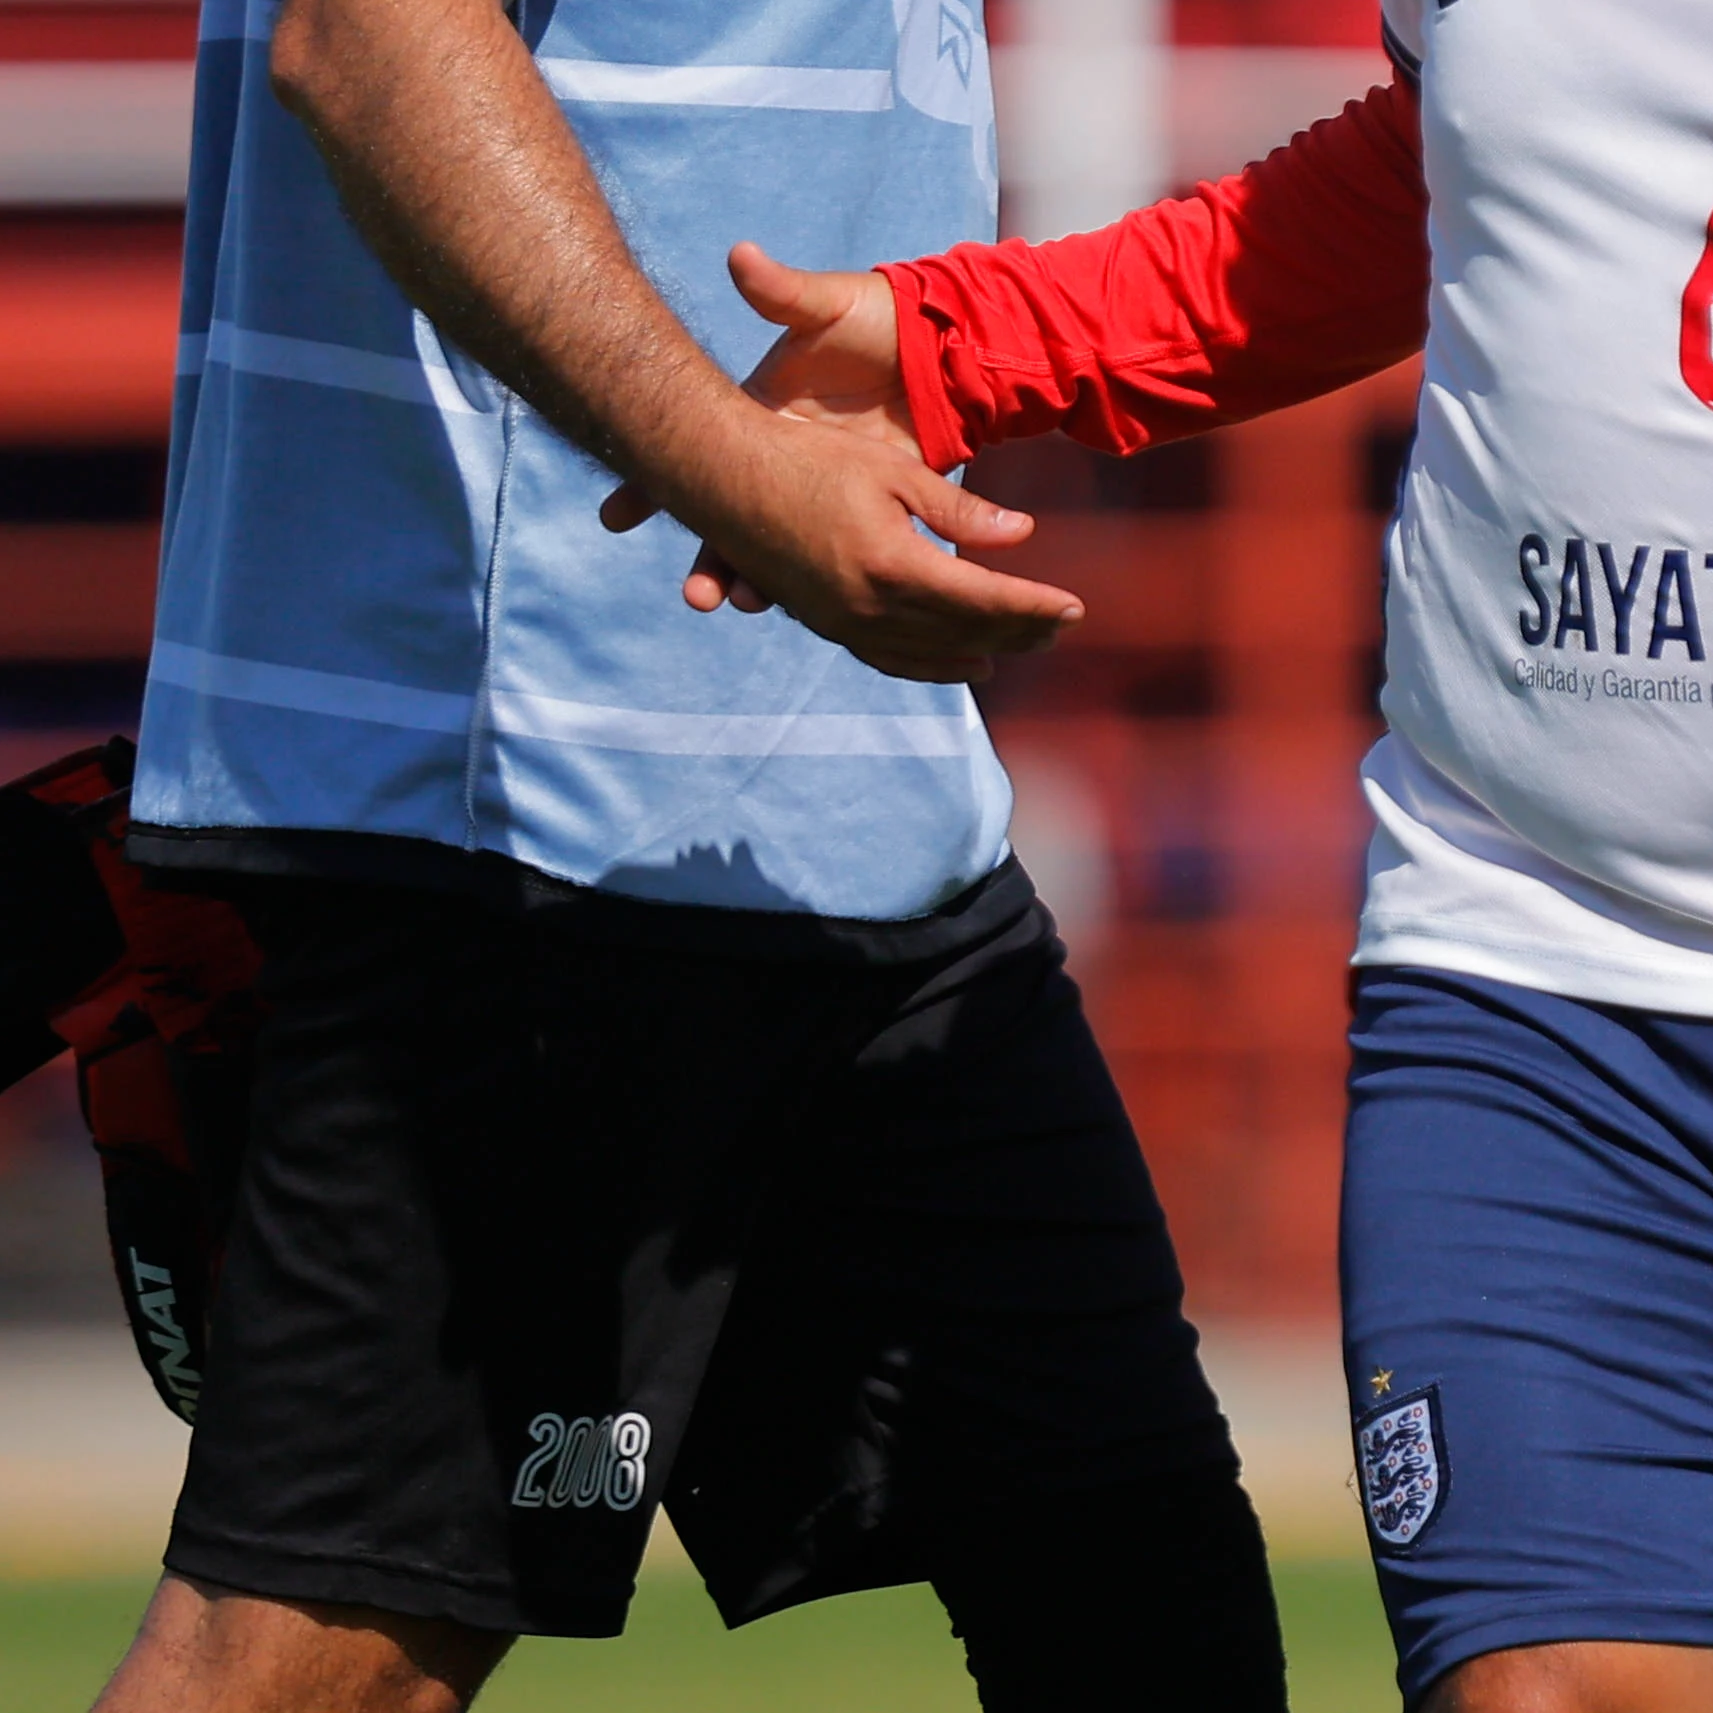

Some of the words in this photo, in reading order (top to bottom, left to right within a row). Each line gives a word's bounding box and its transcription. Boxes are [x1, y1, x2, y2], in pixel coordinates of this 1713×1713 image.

[1513, 658, 1578, 694] Calidad
[1583, 674, 1596, 701] y
[1602, 669, 1703, 704] Garantía
[511, 1411, 653, 1512] 2008
